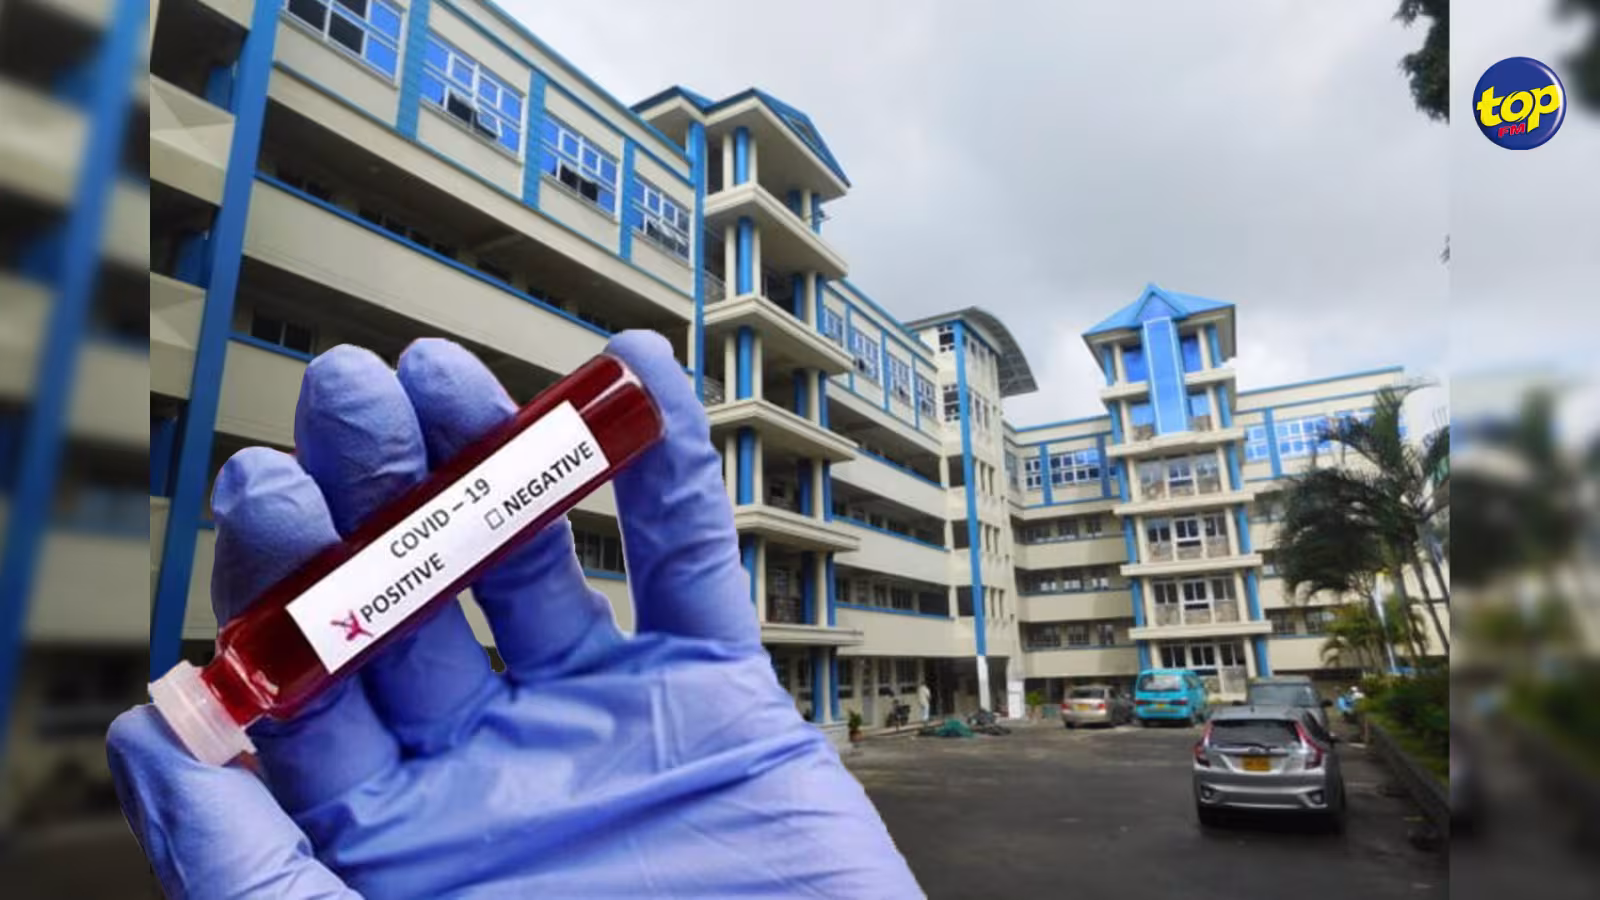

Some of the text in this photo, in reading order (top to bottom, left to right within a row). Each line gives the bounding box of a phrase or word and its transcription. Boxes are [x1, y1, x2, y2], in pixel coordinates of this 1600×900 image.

[502, 441, 595, 516] NEGATIVE
[389, 508, 450, 559] COVID
[466, 478, 491, 505] 19
[360, 552, 446, 623] POSITIVE
